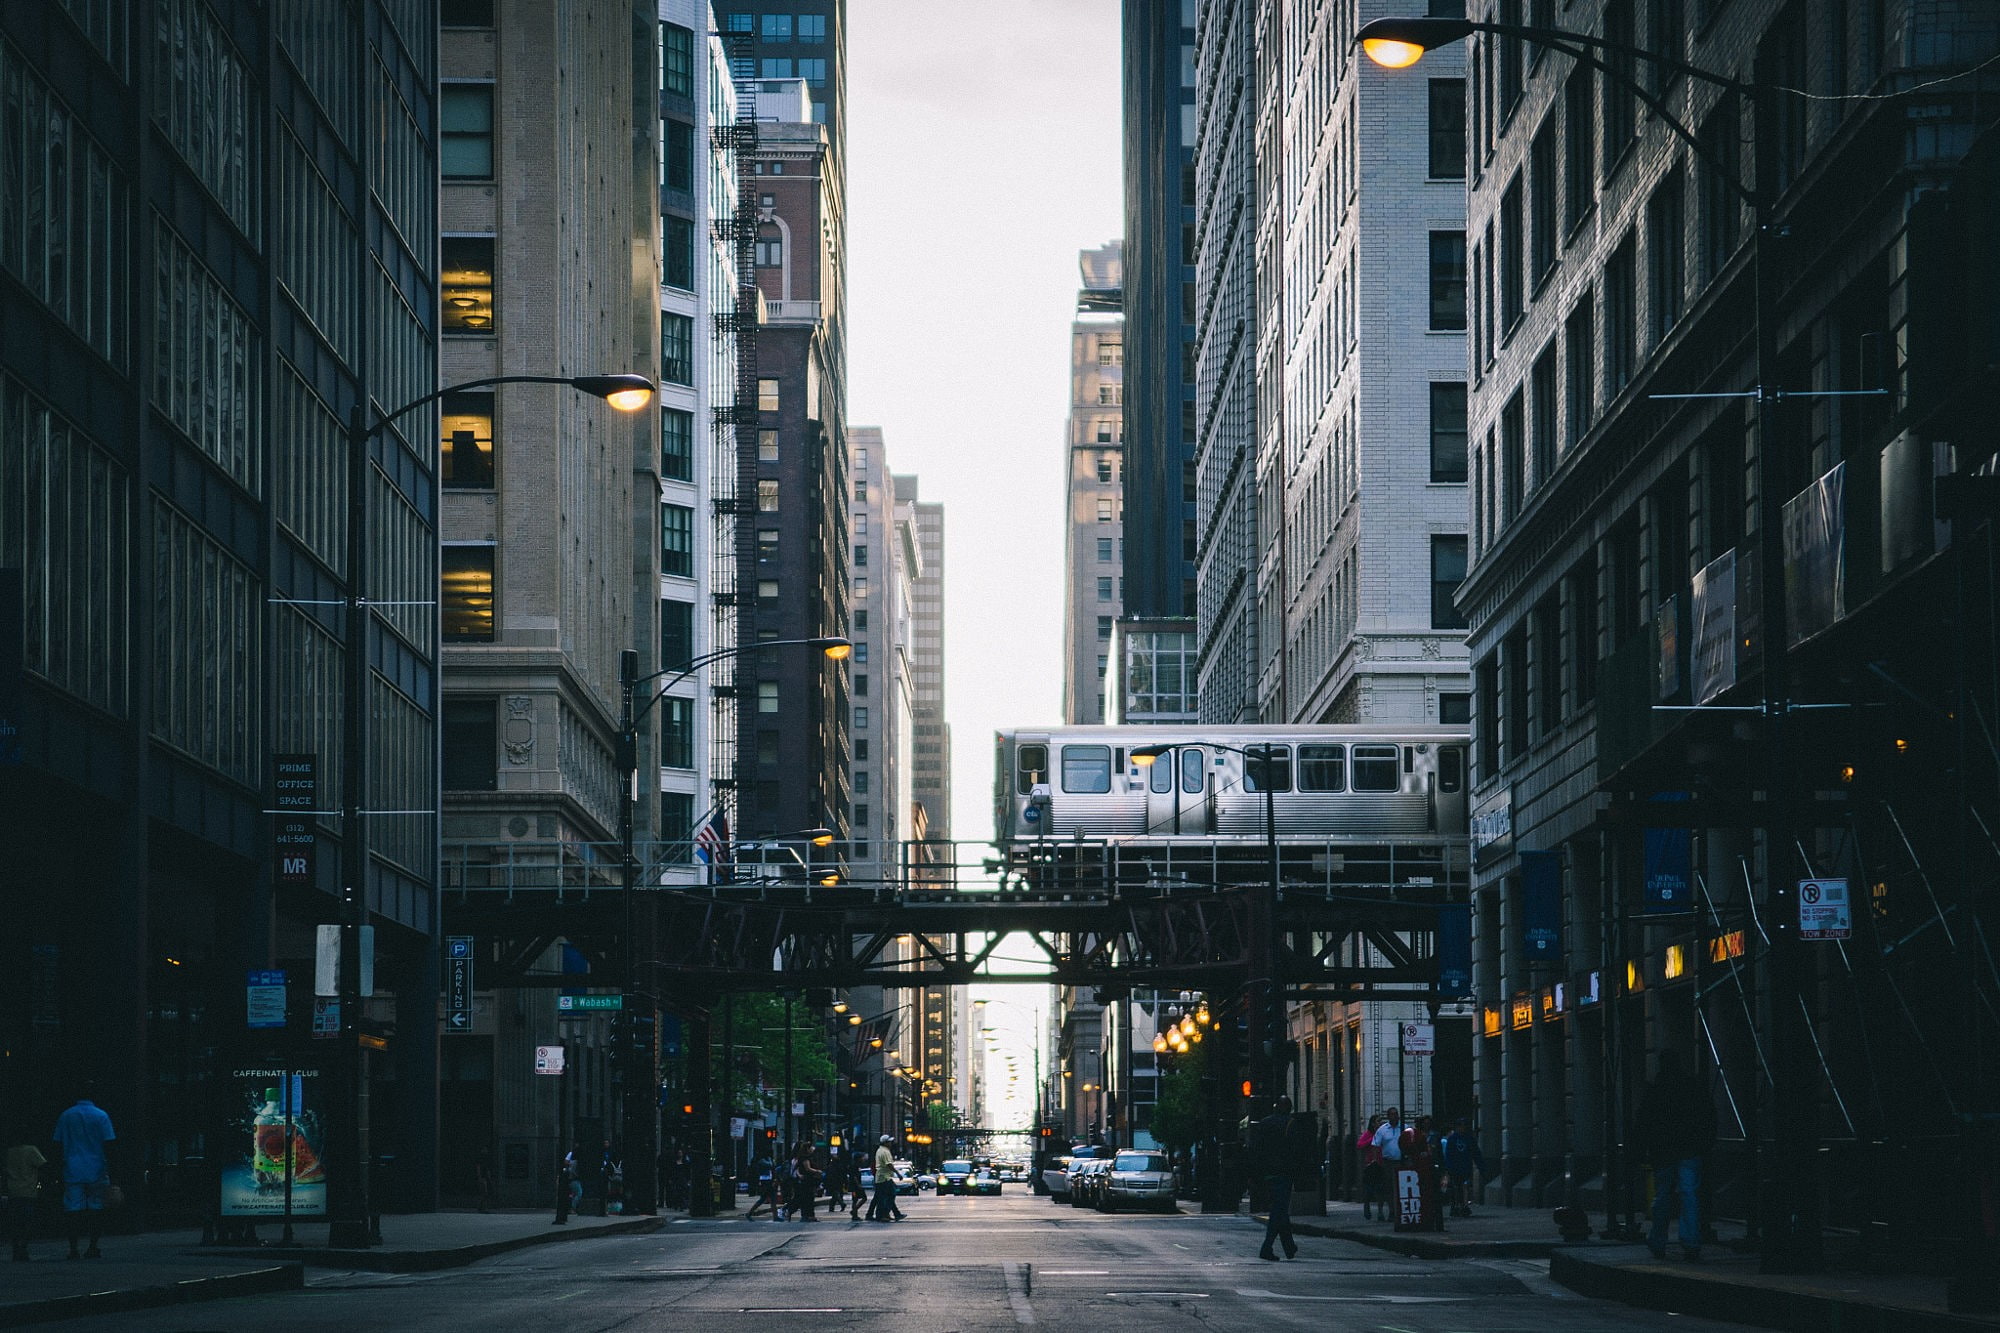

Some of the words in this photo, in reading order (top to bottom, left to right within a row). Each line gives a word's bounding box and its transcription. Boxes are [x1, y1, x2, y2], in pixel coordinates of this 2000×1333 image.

[279, 763, 311, 772] PRIME
[276, 780, 314, 788] OFFICE
[279, 796, 312, 805] SPACE
[286, 824, 305, 832] (312)
[276, 835, 314, 843] 641-5600
[283, 858, 307, 874] MR
[1803, 930, 1820, 938] TOW
[1824, 929, 1847, 937] ZONE
[454, 944, 465, 954] P
[455, 961, 464, 1008] PARKING
[579, 997, 611, 1007] Wabash
[232, 1069, 294, 1077] CAFFEINATE
[295, 1069, 320, 1077] CLUB
[1400, 1214, 1422, 1225] EYE
